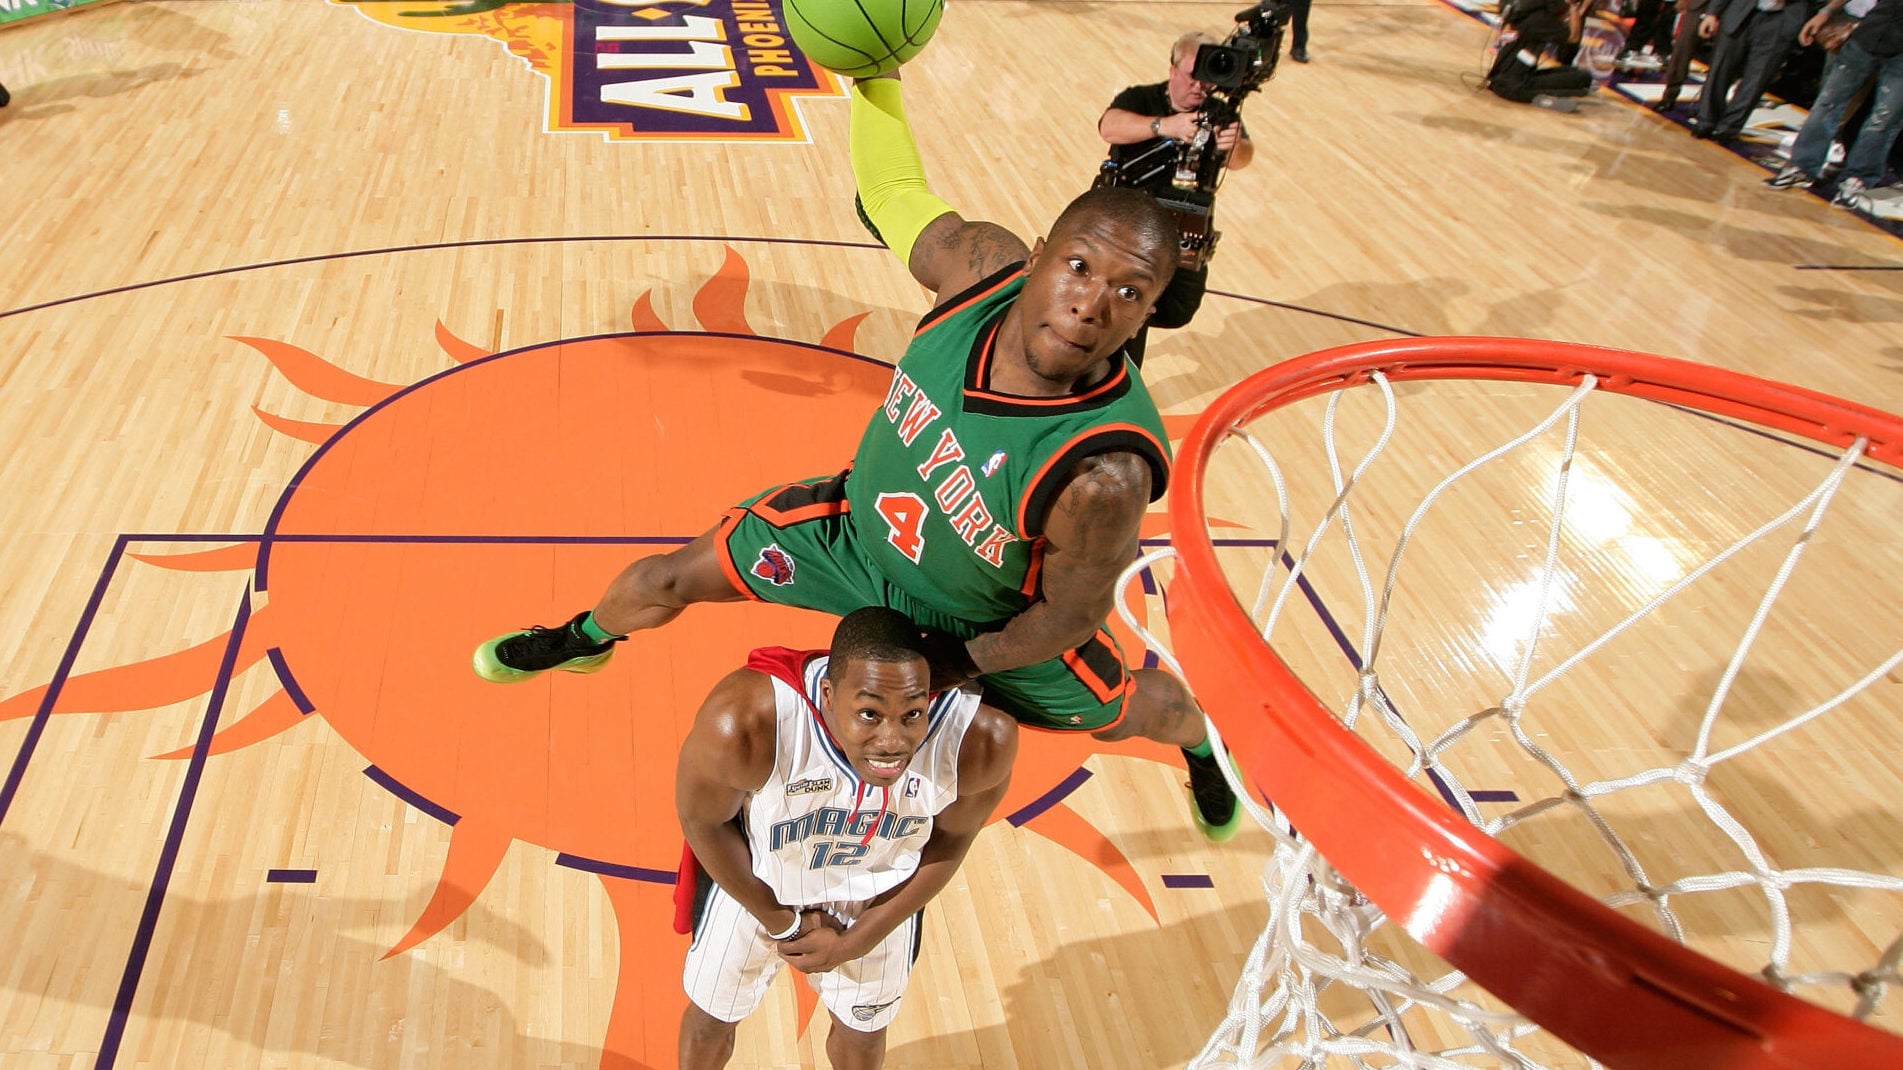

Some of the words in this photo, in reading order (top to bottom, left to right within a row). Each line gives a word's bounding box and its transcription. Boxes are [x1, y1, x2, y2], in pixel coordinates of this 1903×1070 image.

[595, 15, 752, 121] ALL
[730, 0, 799, 76] PHOENI
[874, 491, 930, 566] 4
[917, 427, 1019, 568] YORK
[804, 784, 830, 793] DUNK
[770, 807, 928, 852] MAGIC
[809, 841, 870, 870] 12
